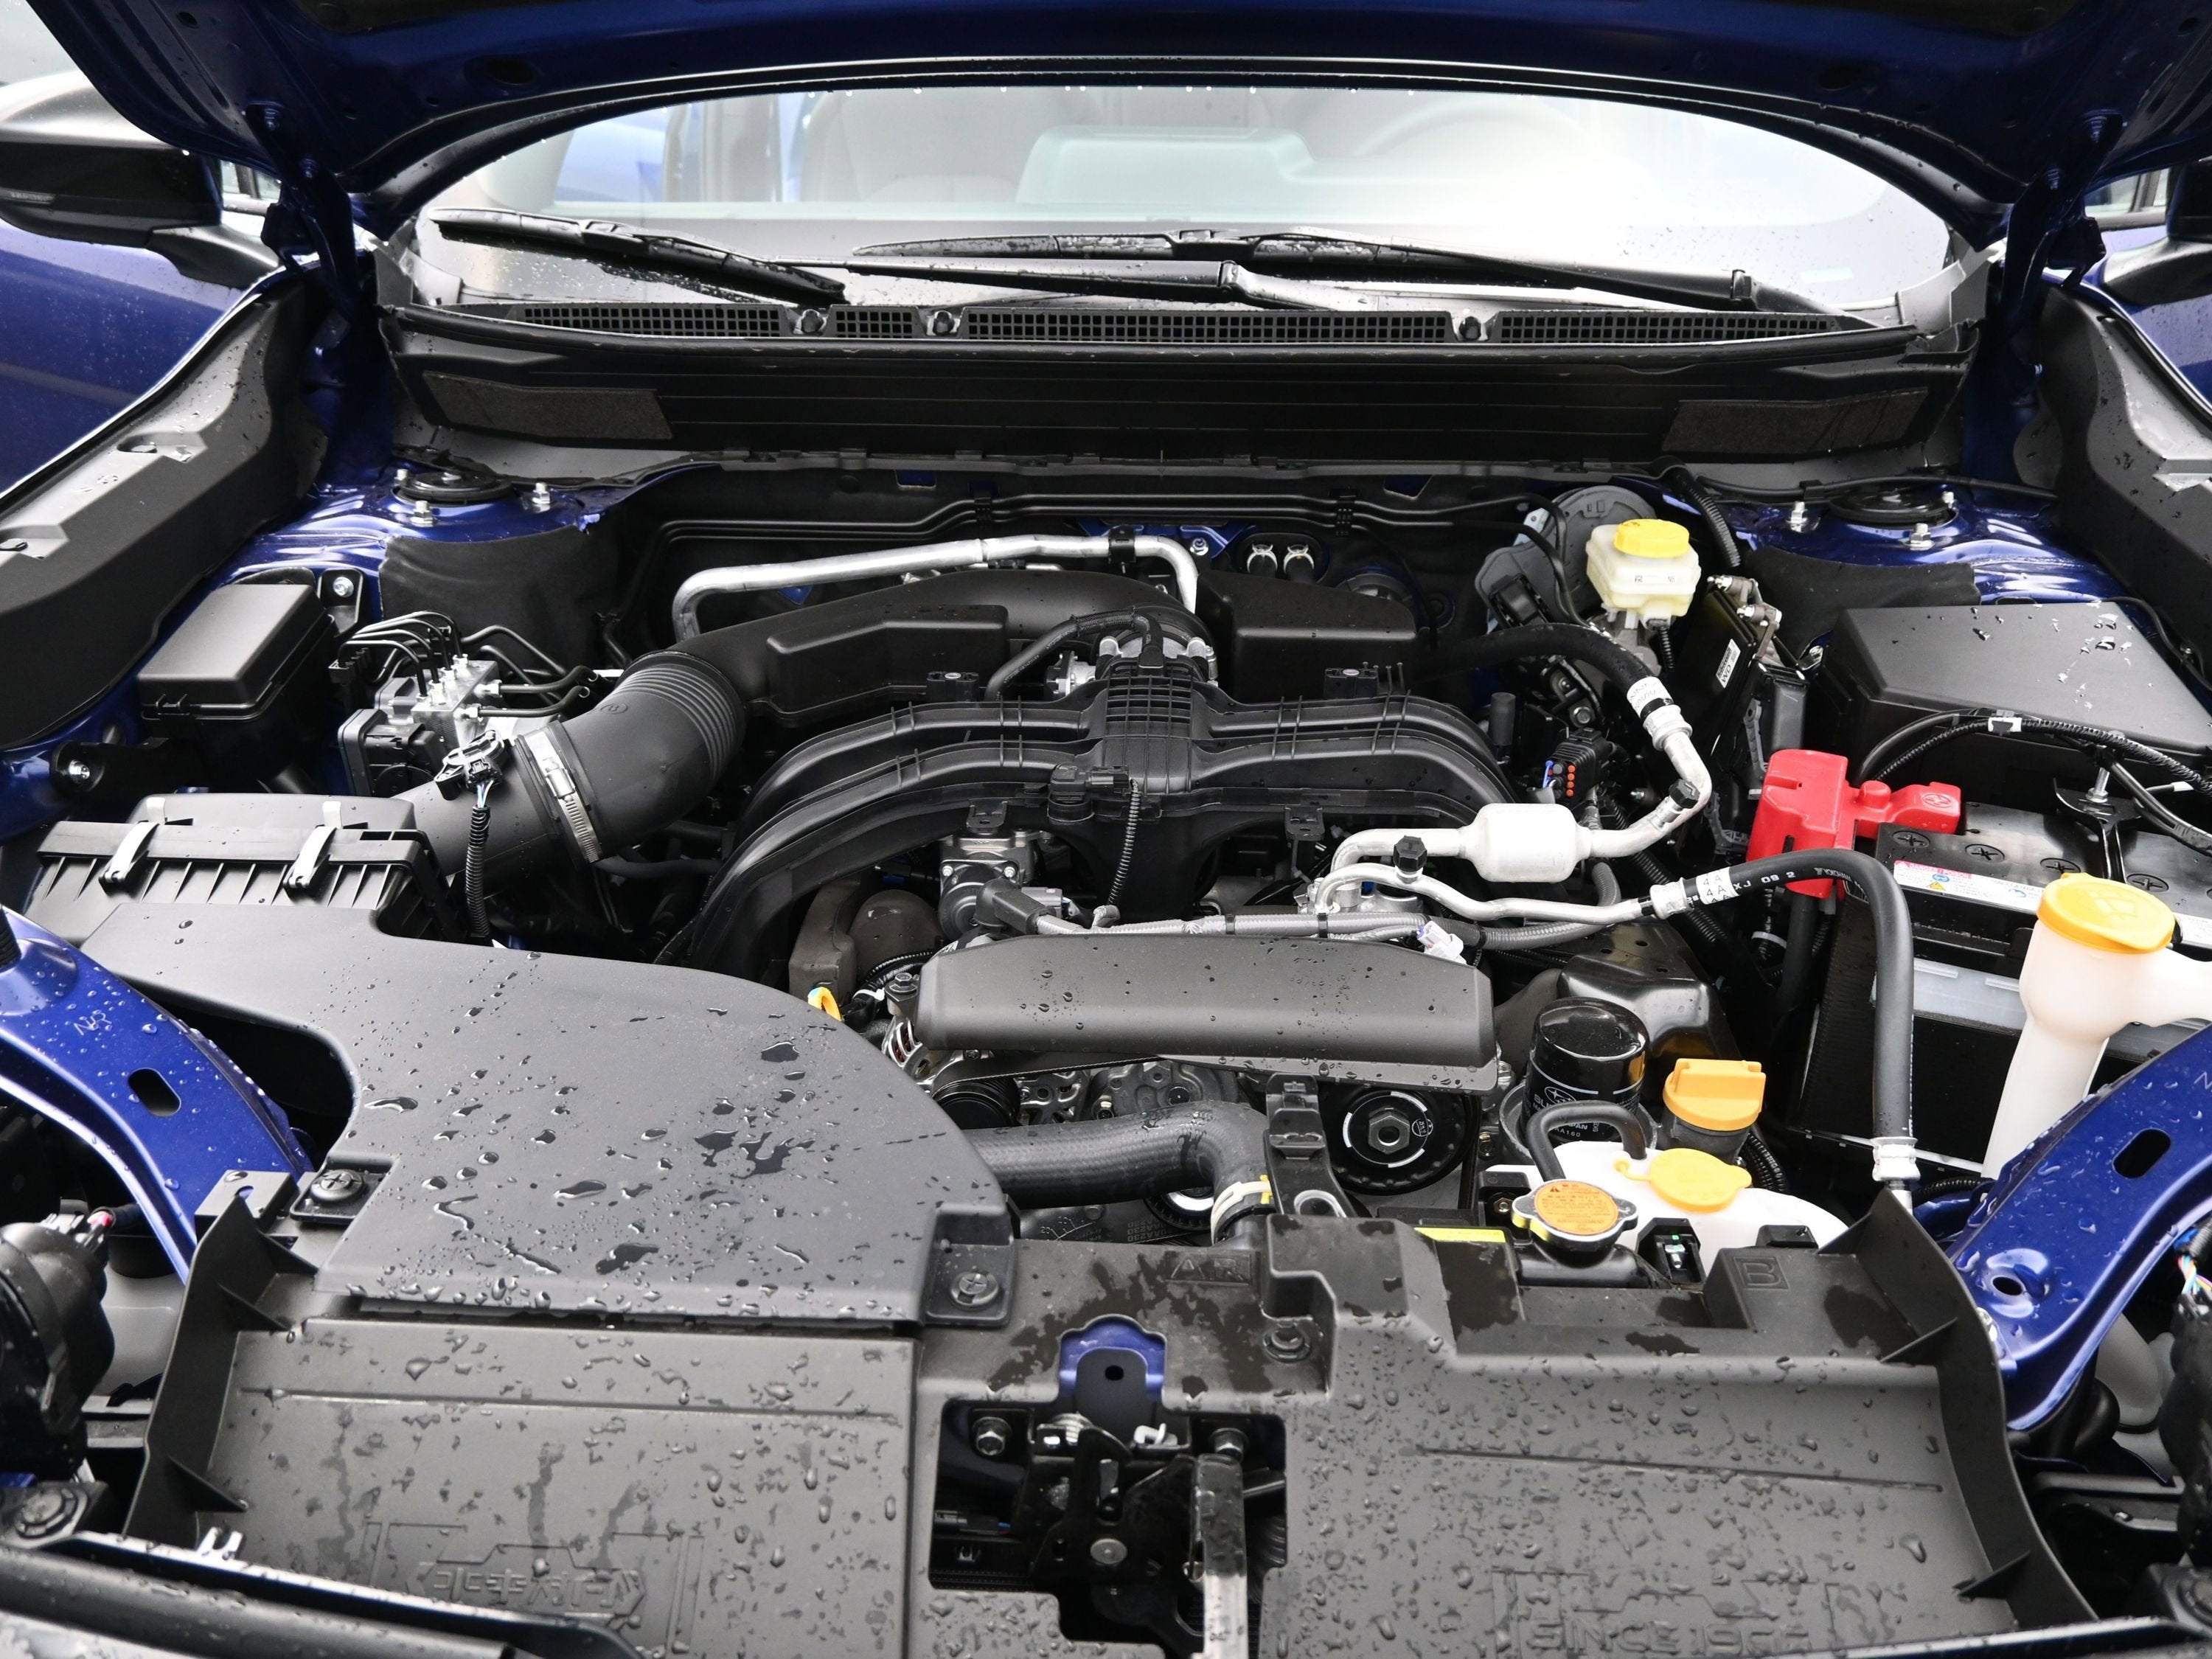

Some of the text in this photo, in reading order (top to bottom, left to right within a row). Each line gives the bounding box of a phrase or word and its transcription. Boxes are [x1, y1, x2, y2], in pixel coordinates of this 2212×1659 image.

[1706, 885, 1727, 897] 4 A
[1742, 1262, 1781, 1287] B
[1527, 1620, 1681, 1656] SINCE
